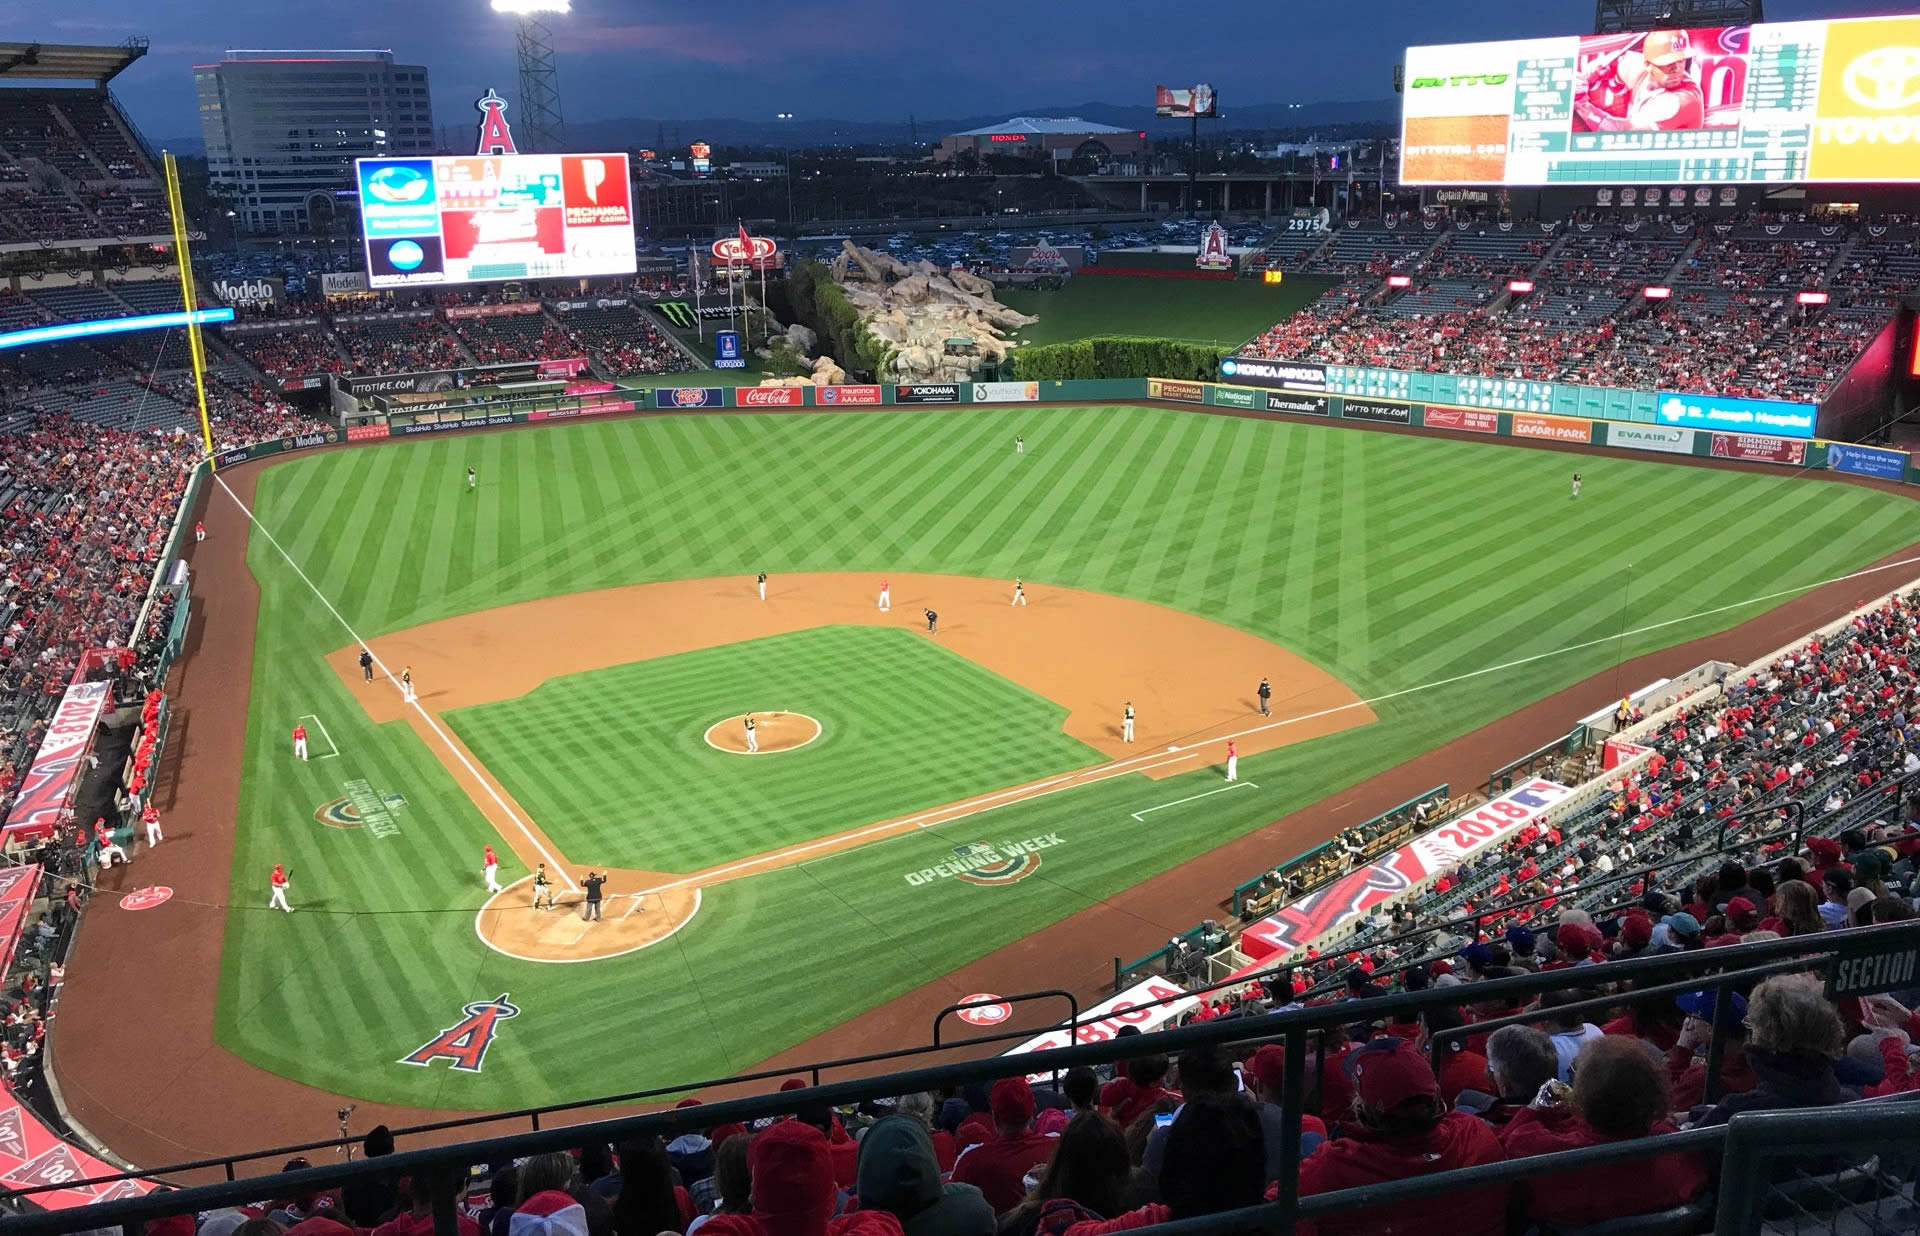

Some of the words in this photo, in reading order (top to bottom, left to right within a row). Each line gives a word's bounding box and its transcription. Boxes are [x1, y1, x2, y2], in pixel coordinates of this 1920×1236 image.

[991, 133, 1026, 142] HONDA
[1288, 219, 1320, 230] 2975
[327, 276, 362, 289] Modelo
[212, 278, 273, 301] Modelo
[352, 378, 414, 393] ITTOTIRE.COM
[912, 386, 955, 395] YOKOHAMA
[1163, 385, 1201, 395] PECHANGA
[841, 395, 875, 403] AAA.com
[1225, 391, 1252, 401] National
[1269, 397, 1317, 411] Thermador
[1345, 404, 1369, 413] NITTO
[1371, 406, 1408, 418] TIRE.COM
[405, 425, 432, 433] StubHub
[433, 422, 459, 431] StubHub
[461, 417, 486, 426] StubHub
[488, 415, 513, 424] StubHub
[1464, 419, 1476, 427] FOR
[1516, 424, 1555, 436] SAFARI
[1556, 427, 1587, 440] PARK
[1617, 430, 1642, 439] EVA
[1644, 431, 1666, 441] AIR
[295, 433, 324, 448] Modelo
[1737, 436, 1782, 446] SIMMONS
[1737, 443, 1782, 452] BOBBLEHEAD
[1744, 448, 1760, 456] MAY
[225, 452, 248, 465] Fanatics
[1846, 450, 1861, 459] Help
[1861, 452, 1867, 460] is
[53, 699, 98, 735] 2018
[1439, 801, 1529, 849] 2018
[904, 851, 1003, 886] OPENING
[999, 832, 1067, 858] WEEK
[1835, 949, 1918, 992] SECTION
[1066, 1001, 1152, 1044] BIG
